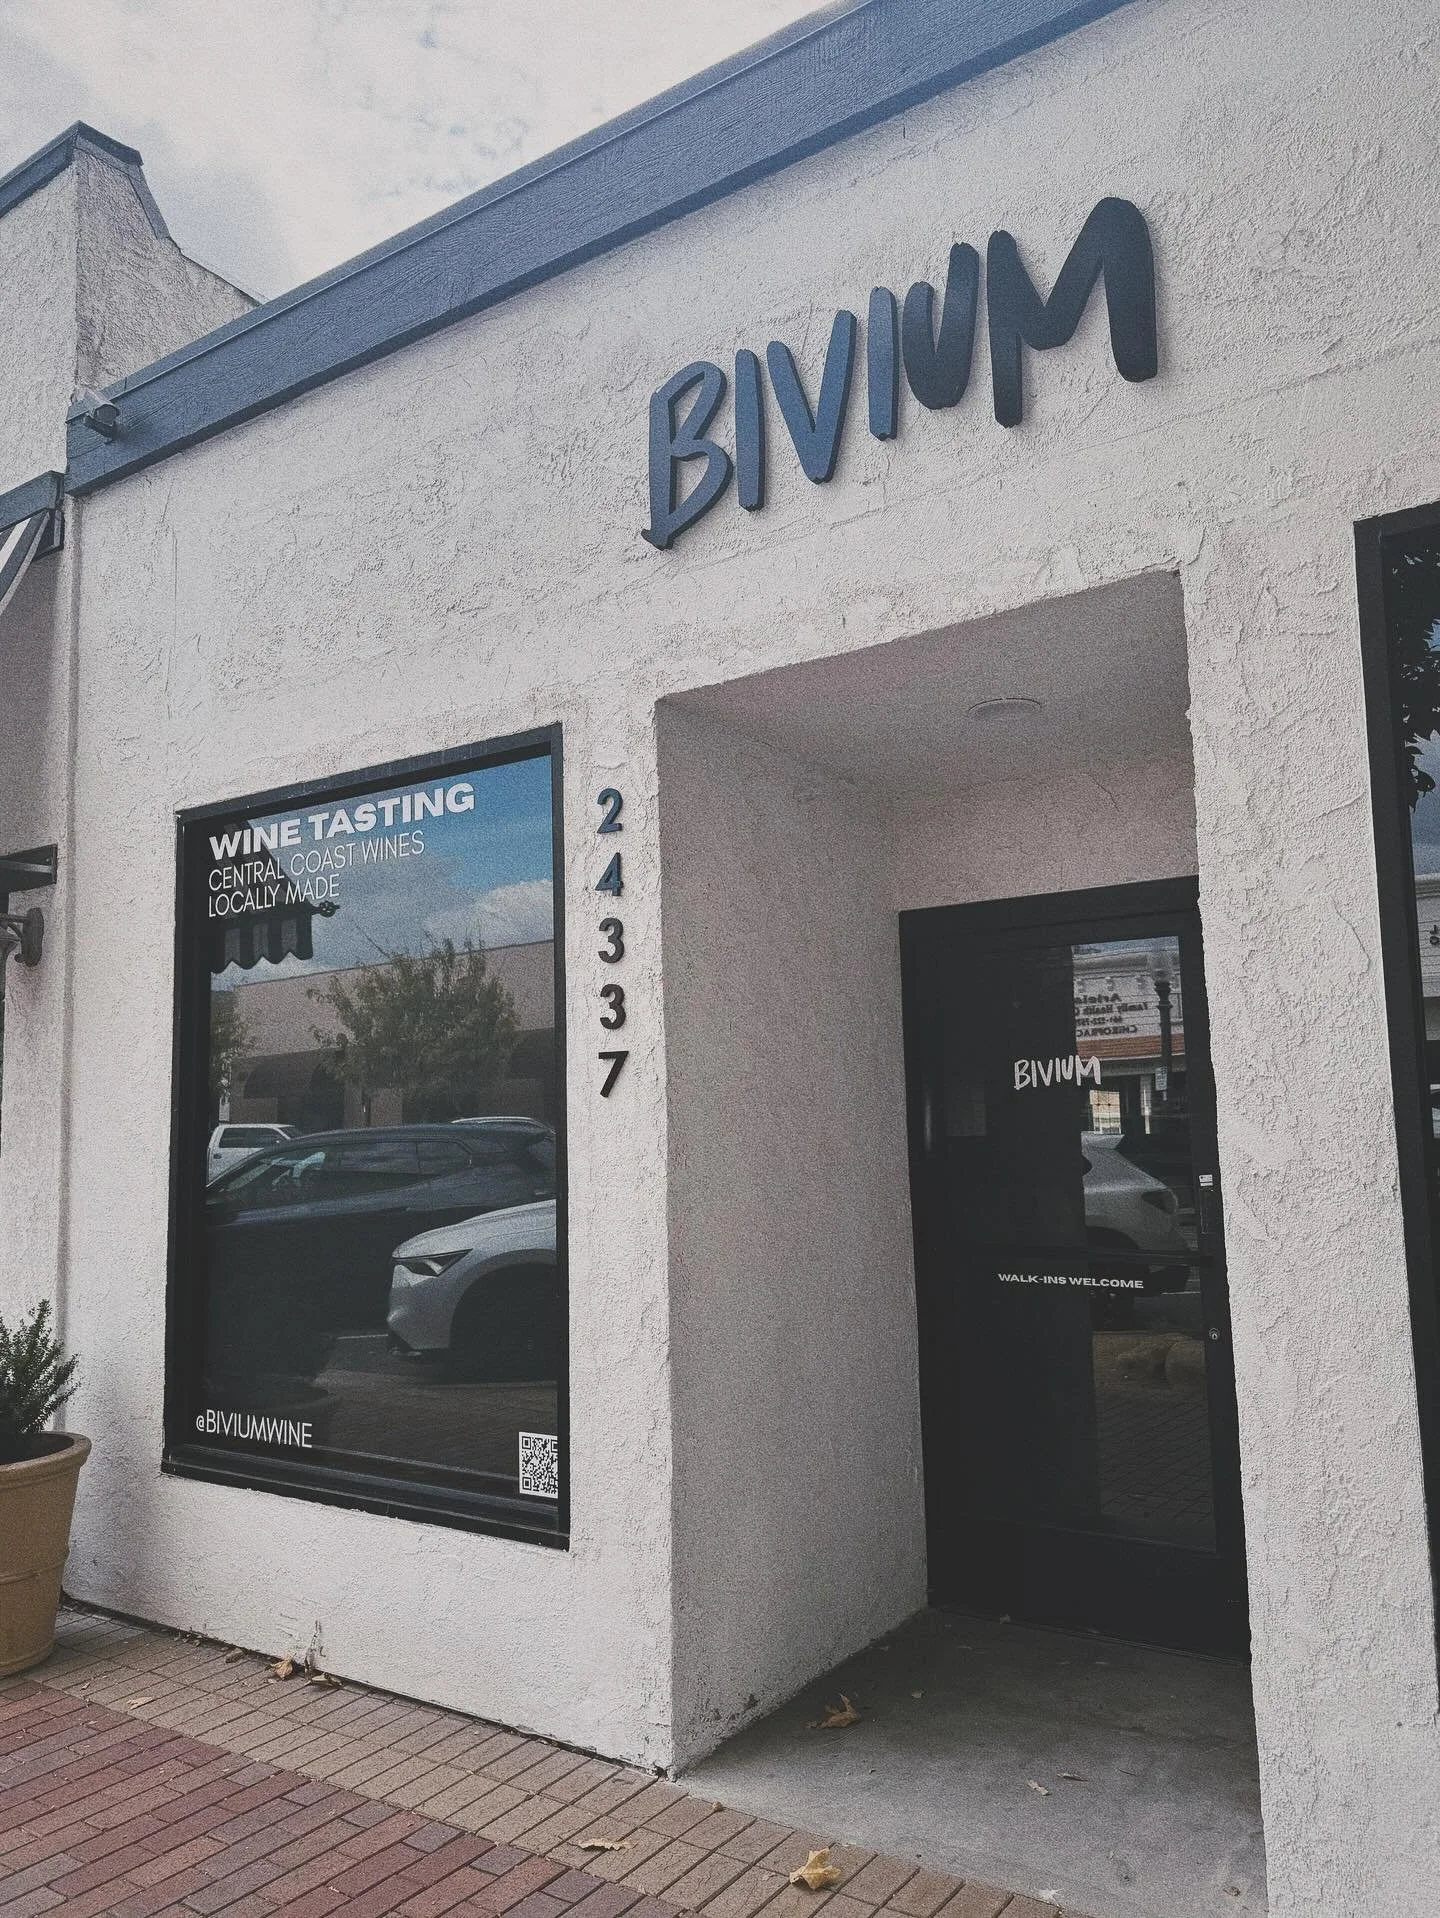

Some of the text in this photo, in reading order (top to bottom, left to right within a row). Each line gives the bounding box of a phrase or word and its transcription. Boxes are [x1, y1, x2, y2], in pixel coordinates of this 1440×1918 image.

[641, 197, 1158, 551] BIVIUM
[209, 782, 475, 861] WINE TASTING
[209, 830, 425, 891] CENTRAL COAST WINES
[208, 873, 340, 918] LOCALLY MADE
[1013, 1055, 1101, 1090] BIVIUM
[997, 1273, 1144, 1289] WALK-INS WELCOME
[195, 1408, 313, 1449] @BIVIUMWINE
